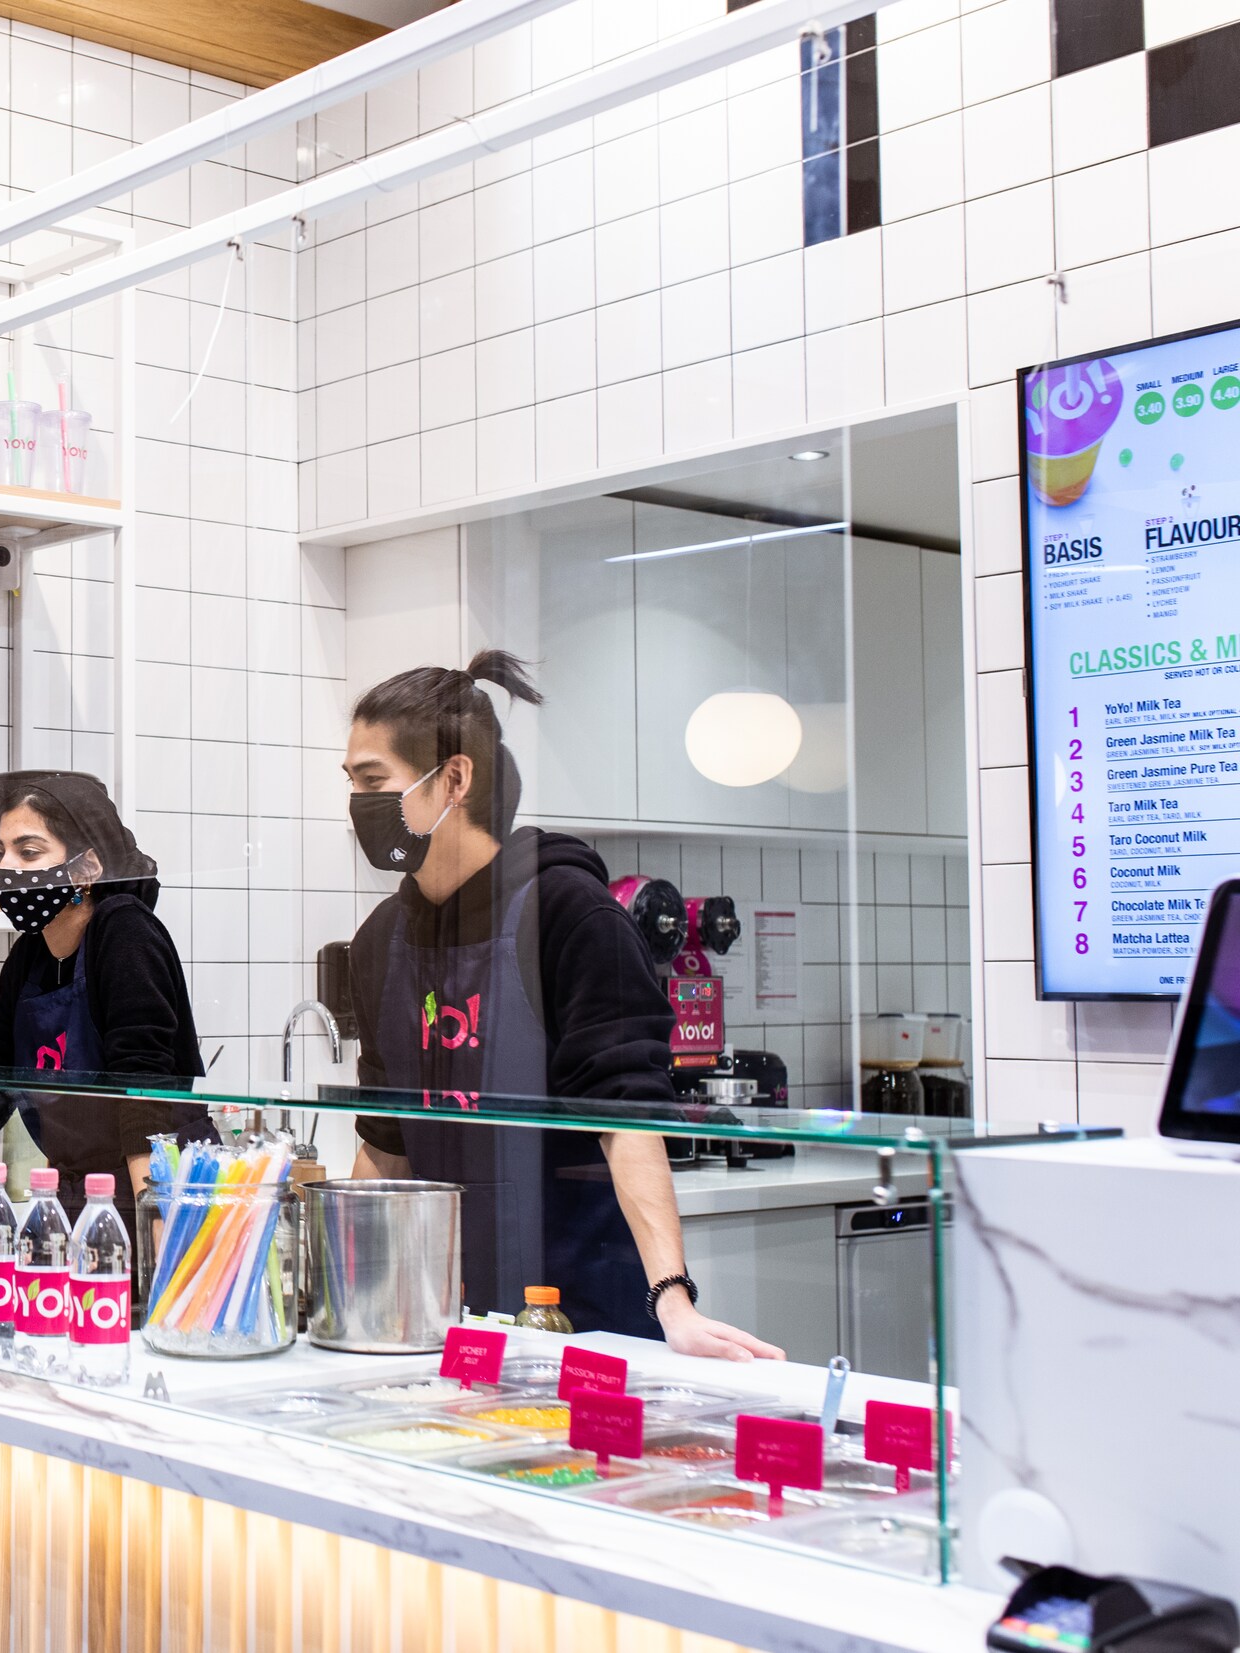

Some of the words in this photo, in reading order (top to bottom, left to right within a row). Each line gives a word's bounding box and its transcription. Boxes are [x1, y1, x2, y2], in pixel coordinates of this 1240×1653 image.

[1213, 363, 1239, 375] LARGE
[1171, 371, 1204, 384] MEDIUM
[1136, 380, 1163, 392] SMALL
[1213, 386, 1240, 401] 4.40
[1137, 401, 1163, 417] 3.40
[1175, 394, 1201, 409] 3.90
[1145, 517, 1167, 527] STEP
[1044, 533, 1064, 543] STEP
[1044, 536, 1103, 565] BASIS
[1151, 551, 1198, 563] STRAWBERRY
[1151, 565, 1176, 574] LEMON
[1049, 579, 1078, 589] YOGHURT
[1080, 576, 1102, 585] SHAKE
[1152, 572, 1201, 585] PASSIONFRUIT
[1049, 591, 1065, 600] MILK
[1066, 588, 1088, 598] SHAKE
[1152, 585, 1190, 596] HONEYDEW
[1049, 602, 1062, 611] SOY
[1064, 600, 1080, 608] MILK
[1081, 597, 1103, 606] SHAKE
[1152, 598, 1178, 608] LYCHEE
[1153, 609, 1178, 619] MANGO
[1069, 640, 1182, 675] CLASSICS
[1190, 638, 1208, 662] &
[1216, 634, 1240, 659] M
[1164, 669, 1194, 680] SERVED
[1195, 667, 1210, 677] HOT
[1212, 666, 1223, 675] OR
[1225, 664, 1240, 674] COL
[1069, 707, 1079, 728] 1
[1105, 702, 1133, 715] YoYo!
[1137, 699, 1160, 712] Milk
[1162, 698, 1181, 710] Tea
[1105, 717, 1122, 726] EARL
[1124, 715, 1141, 724] GREY
[1160, 712, 1176, 721] MILK
[1069, 739, 1083, 761] 2
[1106, 736, 1137, 748] Green
[1140, 732, 1186, 745] Jasmine
[1189, 729, 1214, 741] Milk
[1216, 727, 1236, 739] Tea
[1070, 771, 1084, 793] 3
[1107, 769, 1138, 781] Green
[1141, 765, 1187, 778] Jasmine
[1190, 763, 1216, 774] Pure
[1219, 761, 1238, 772] Tea
[1107, 782, 1147, 791] SWEETENED
[1149, 780, 1171, 788] GREEN
[1206, 776, 1220, 784] TEA
[1071, 803, 1085, 824] 4
[1108, 802, 1131, 813] Taro
[1134, 799, 1158, 811] Milk
[1160, 799, 1179, 810] Tea
[1072, 836, 1086, 857] 5
[1109, 835, 1132, 846] Taro
[1135, 832, 1180, 845] Coconut
[1183, 830, 1208, 842] Milk
[1073, 867, 1087, 889] 6
[1110, 866, 1155, 878] Coconut
[1157, 865, 1181, 876] Milk
[1073, 900, 1088, 922] 7
[1111, 899, 1165, 912] Chocolate
[1168, 898, 1192, 910] Milk
[1194, 898, 1206, 910] Te
[1075, 932, 1090, 955] 8
[1112, 932, 1152, 944] Matcha
[1155, 932, 1190, 944] Lattea
[1112, 947, 1140, 955] MATCHA
[1159, 976, 1174, 984] ONE
[678, 1021, 715, 1041] YOYO!
[13, 1278, 69, 1318] YO!
[69, 1287, 128, 1329] YO!
